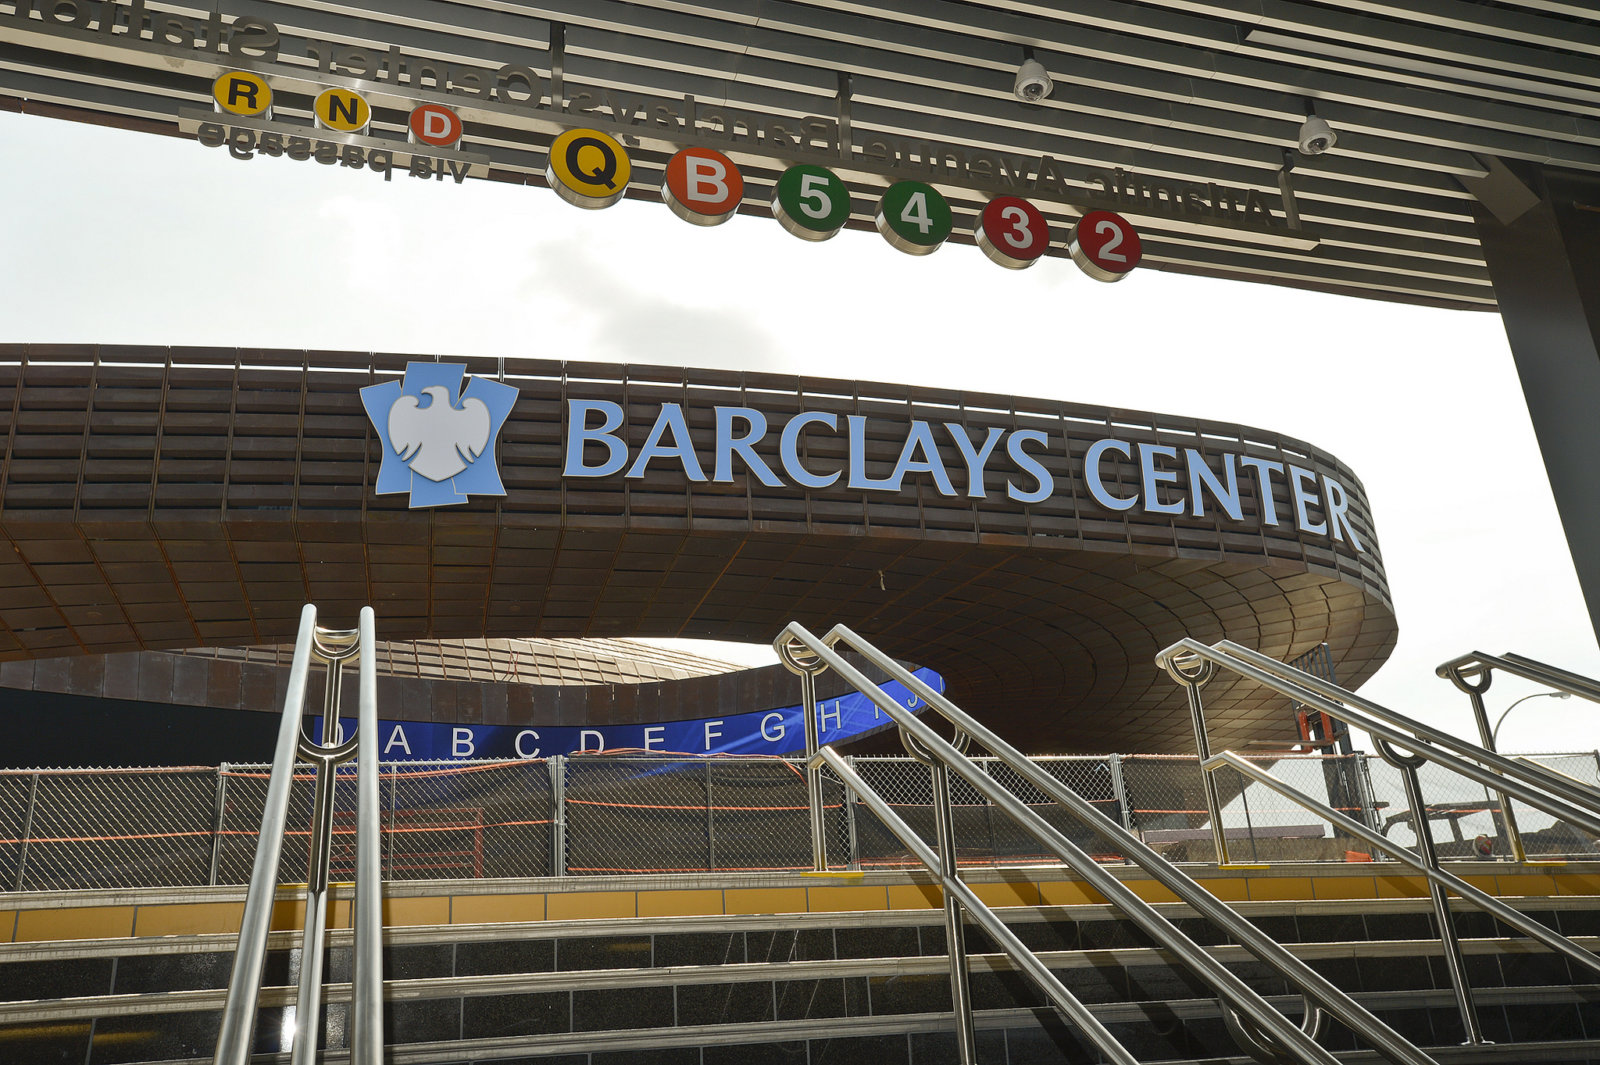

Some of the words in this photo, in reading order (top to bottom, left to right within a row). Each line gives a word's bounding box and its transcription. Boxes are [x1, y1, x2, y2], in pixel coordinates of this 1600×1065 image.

[227, 78, 258, 109] R
[328, 95, 358, 124] N
[423, 110, 451, 138] D
[566, 137, 616, 190] Q
[685, 156, 729, 203] B
[799, 173, 832, 219] 5
[901, 192, 933, 234] 4
[1001, 206, 1033, 249] 3
[1095, 220, 1127, 263] 2
[563, 399, 1055, 503] BARCLAYS
[1085, 438, 1365, 552] CENTER
[384, 725, 411, 754] A
[452, 727, 475, 757] B
[514, 730, 540, 759] C
[580, 730, 604, 754] D
[644, 726, 665, 754] E
[704, 721, 723, 750] F
[760, 712, 785, 741] G
[820, 700, 841, 732] H
